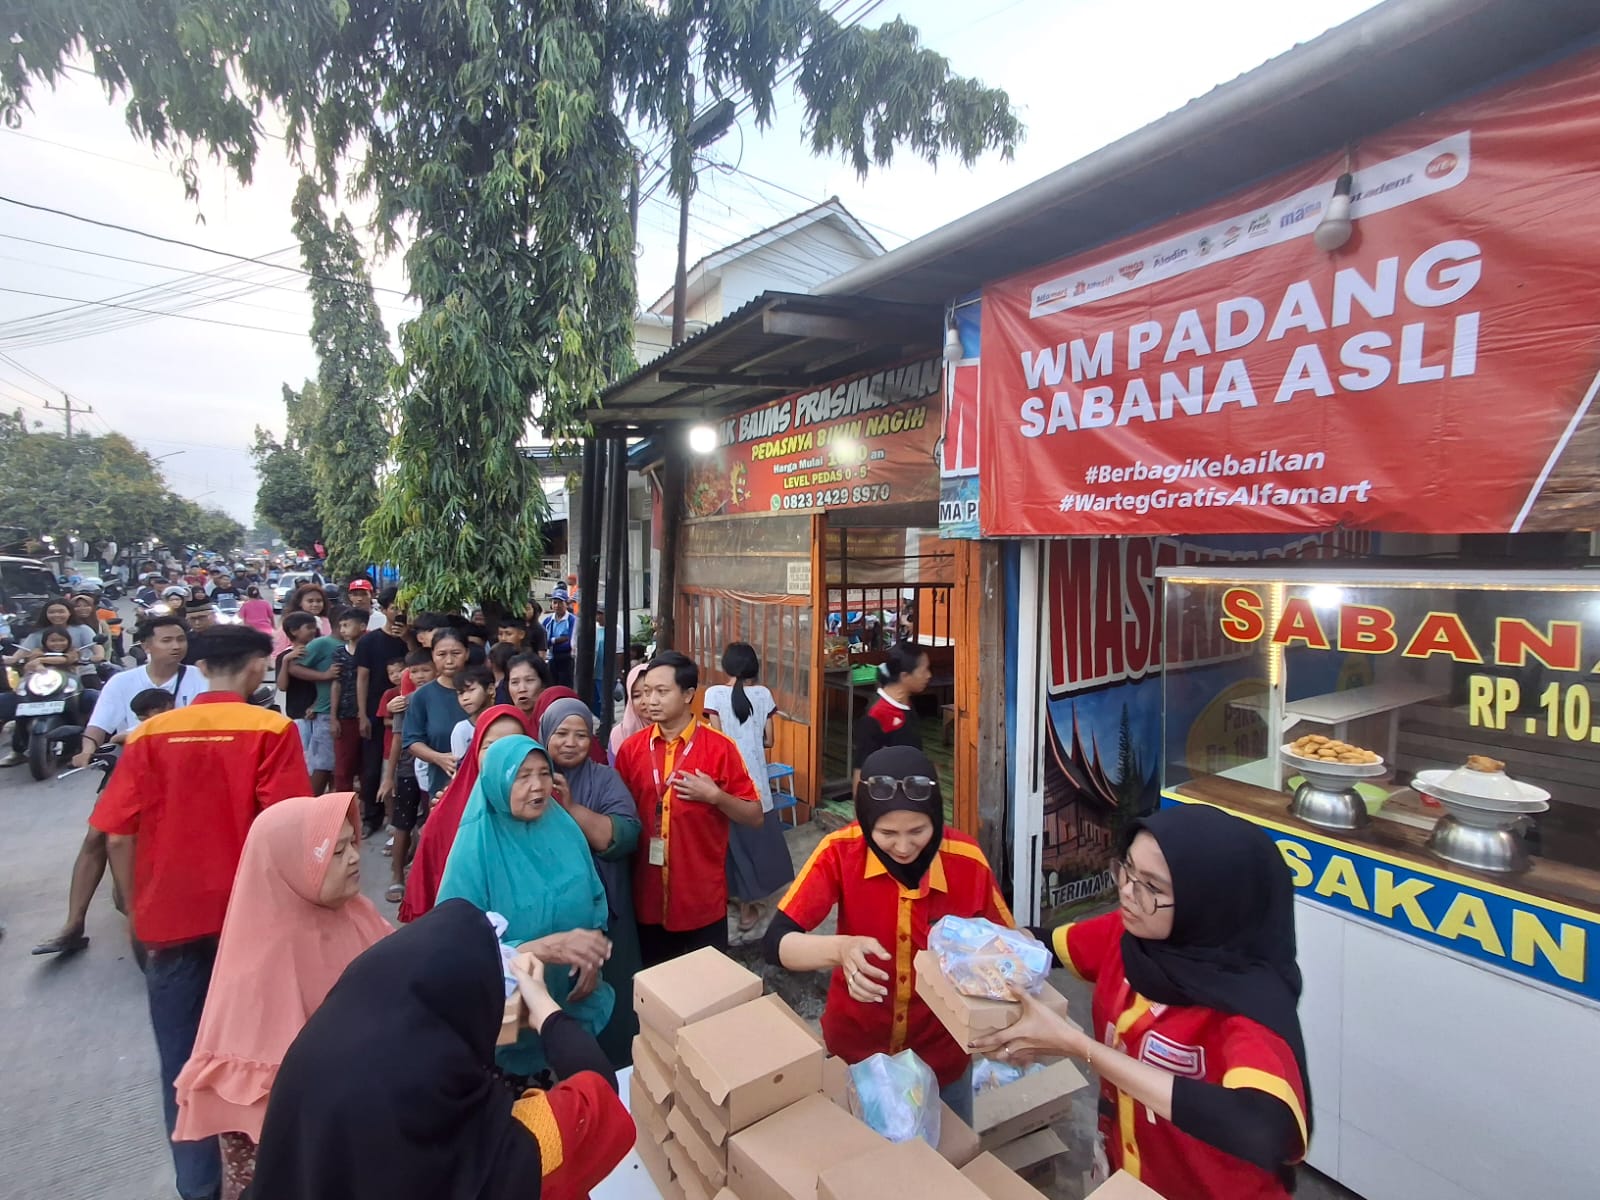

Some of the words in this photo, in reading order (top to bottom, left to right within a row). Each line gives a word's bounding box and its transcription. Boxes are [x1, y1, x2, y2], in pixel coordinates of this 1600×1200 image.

[1019, 331, 1114, 390] WM
[1127, 239, 1482, 370] PADANG
[795, 356, 943, 428] PRASMANAN
[1019, 358, 1258, 438] SABANA
[1273, 311, 1481, 404] ASLI
[751, 430, 813, 461] PEDASNYA
[865, 406, 927, 438] NAGIH
[773, 460, 798, 475] Harga
[799, 455, 823, 471] Mulai
[871, 449, 885, 460] an
[783, 473, 811, 490] LEVEL
[811, 469, 843, 485] PEDAS
[1084, 449, 1325, 486] #BerbagiKebaikan
[783, 493, 813, 510] 0823
[816, 487, 849, 506] 2429
[1059, 479, 1371, 514] #WartegGratisAlfamart
[1219, 586, 1600, 673] SABAN
[1051, 873, 1101, 908] TERIMA
